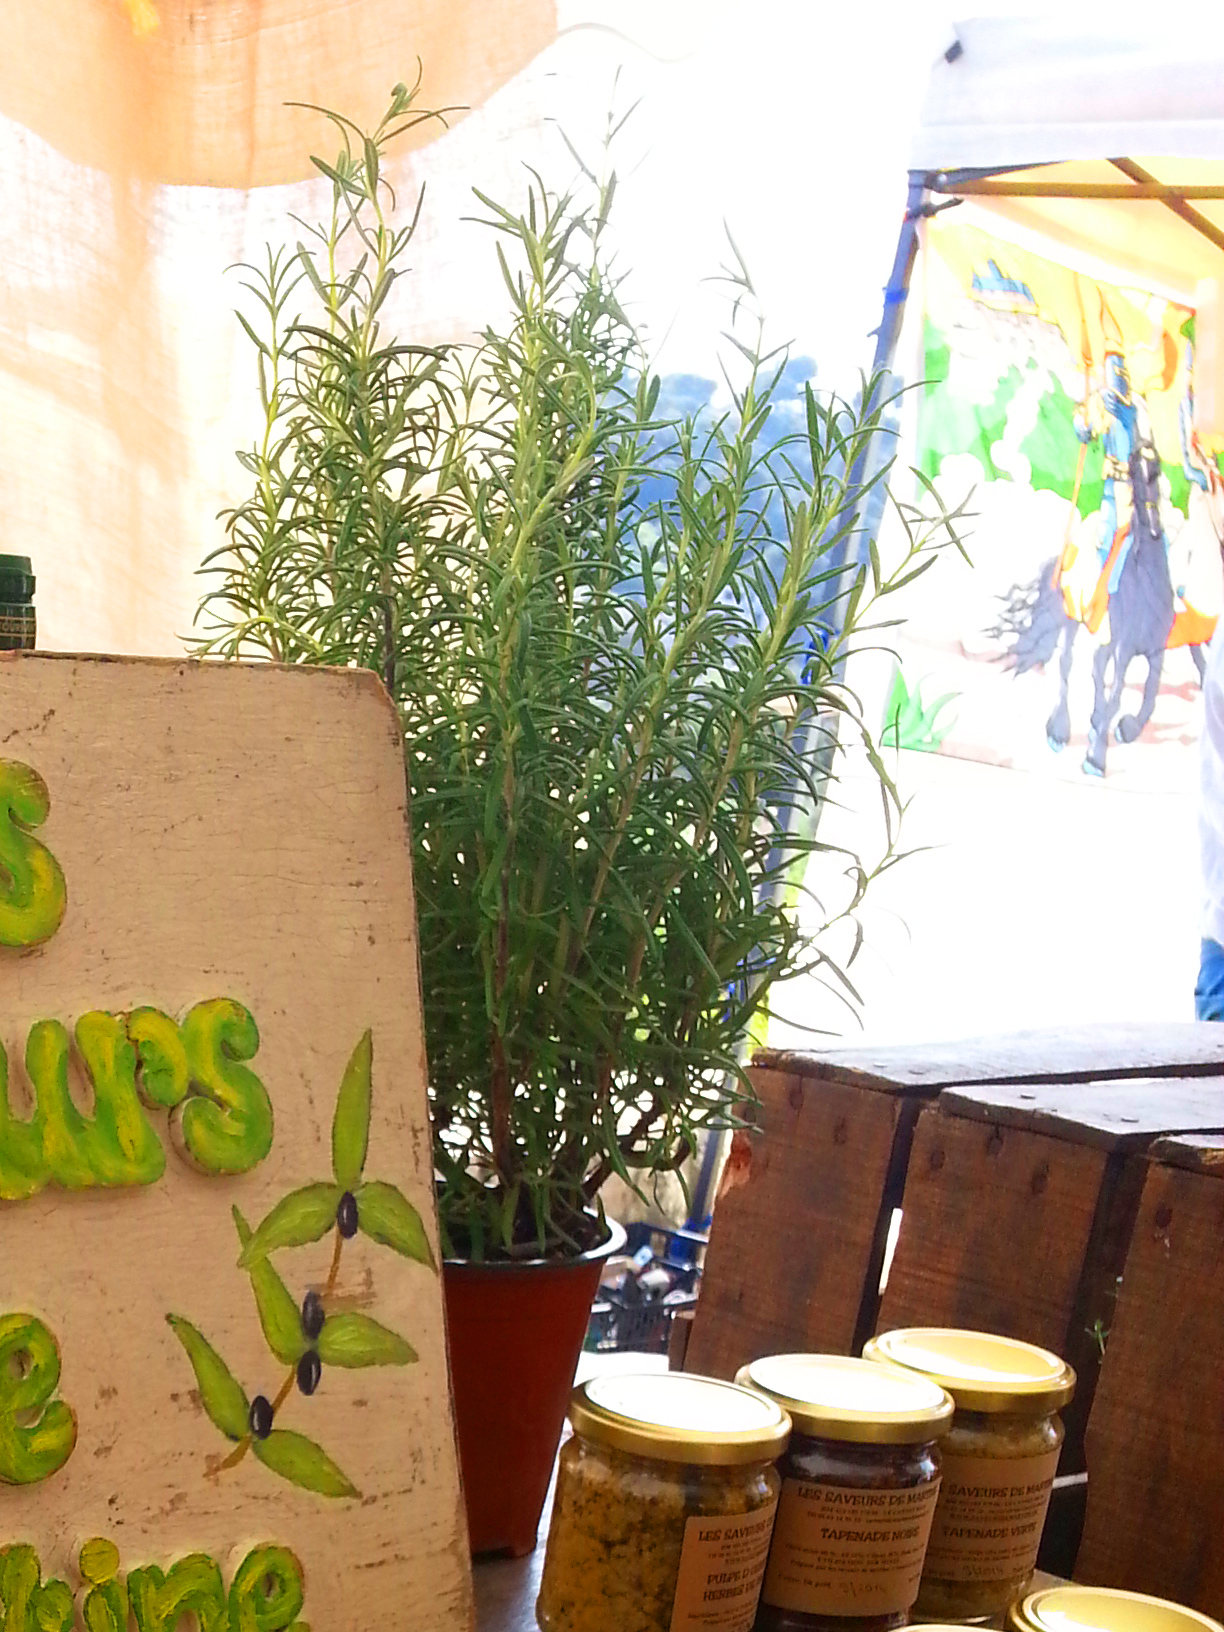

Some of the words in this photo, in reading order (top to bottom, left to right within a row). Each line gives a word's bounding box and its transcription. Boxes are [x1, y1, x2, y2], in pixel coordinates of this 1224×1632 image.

[797, 1487, 823, 1501] LES
[825, 1492, 886, 1507] SAVEURS
[889, 1494, 907, 1506] DE
[698, 1530, 722, 1542] LES
[820, 1528, 890, 1542] TAPENADE
